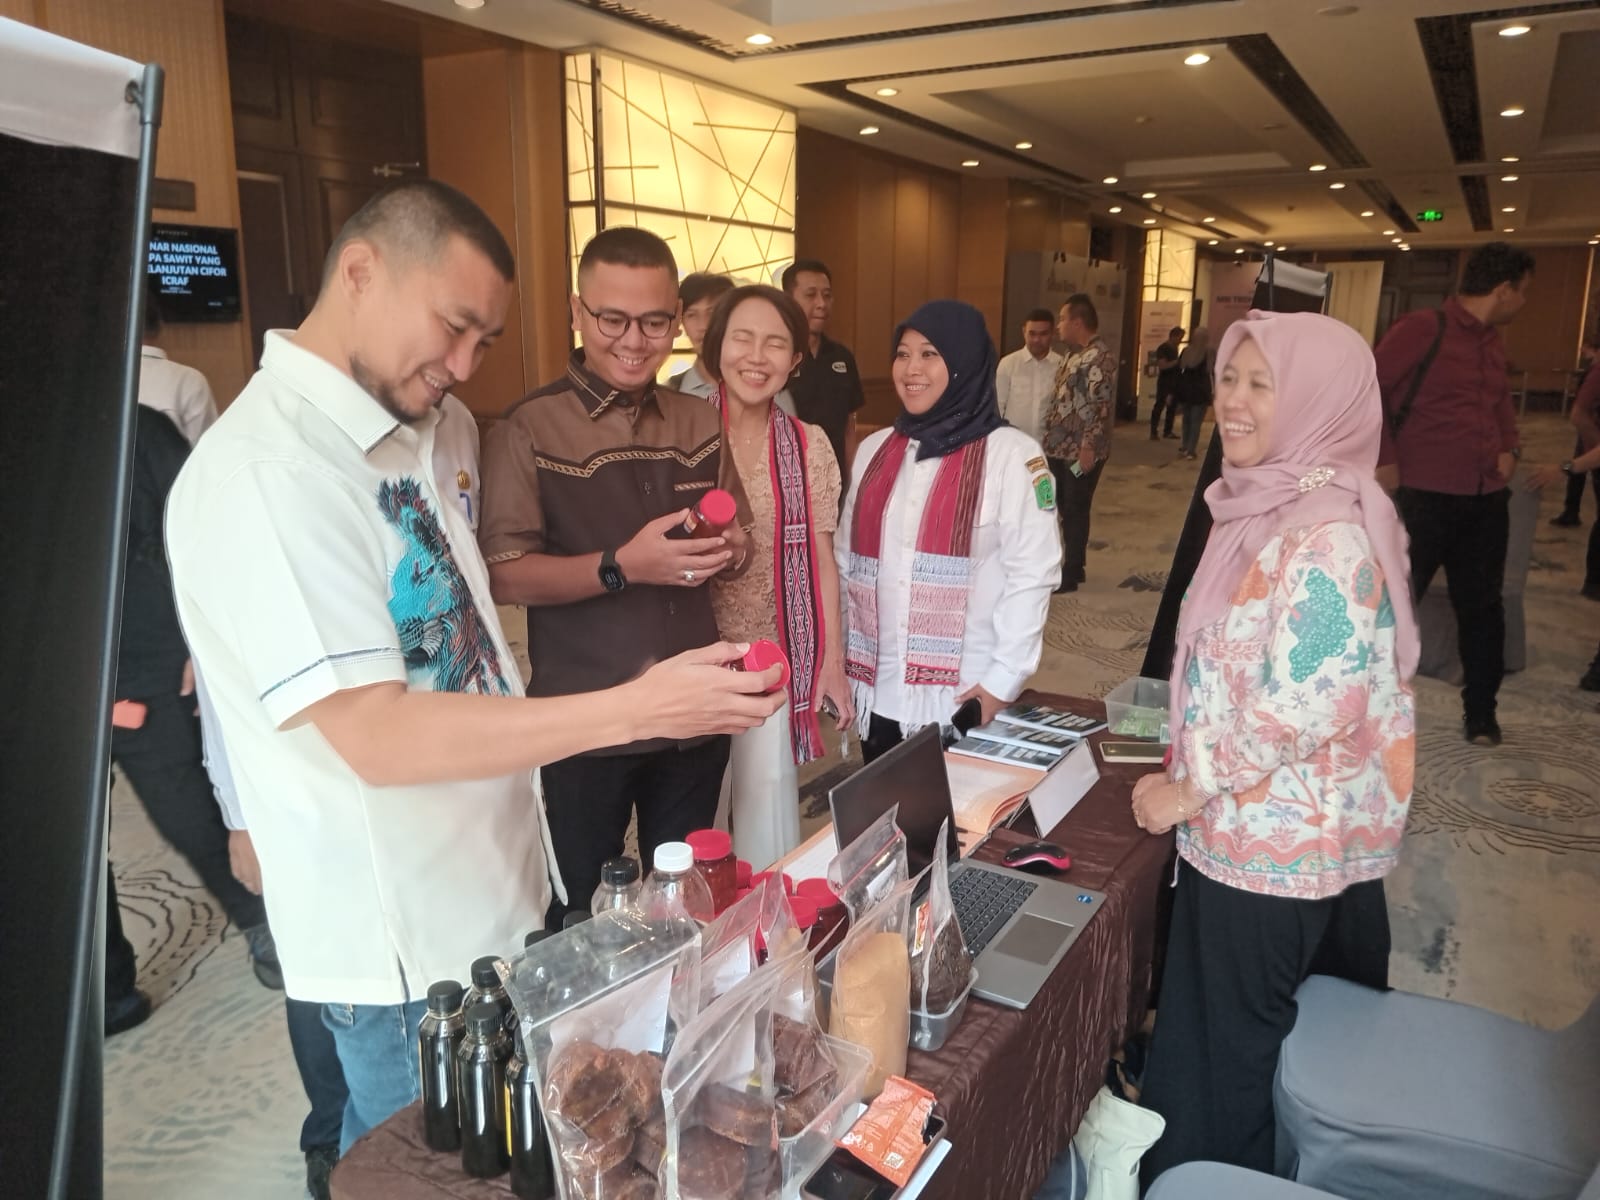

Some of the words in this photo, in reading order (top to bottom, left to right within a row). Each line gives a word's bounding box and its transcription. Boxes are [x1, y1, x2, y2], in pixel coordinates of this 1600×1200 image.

[171, 243, 218, 255] NASIONAL
[163, 254, 194, 265] SAWIT
[195, 255, 221, 266] YANG
[199, 266, 227, 277] CIFOR
[161, 276, 190, 286] ICRAF
